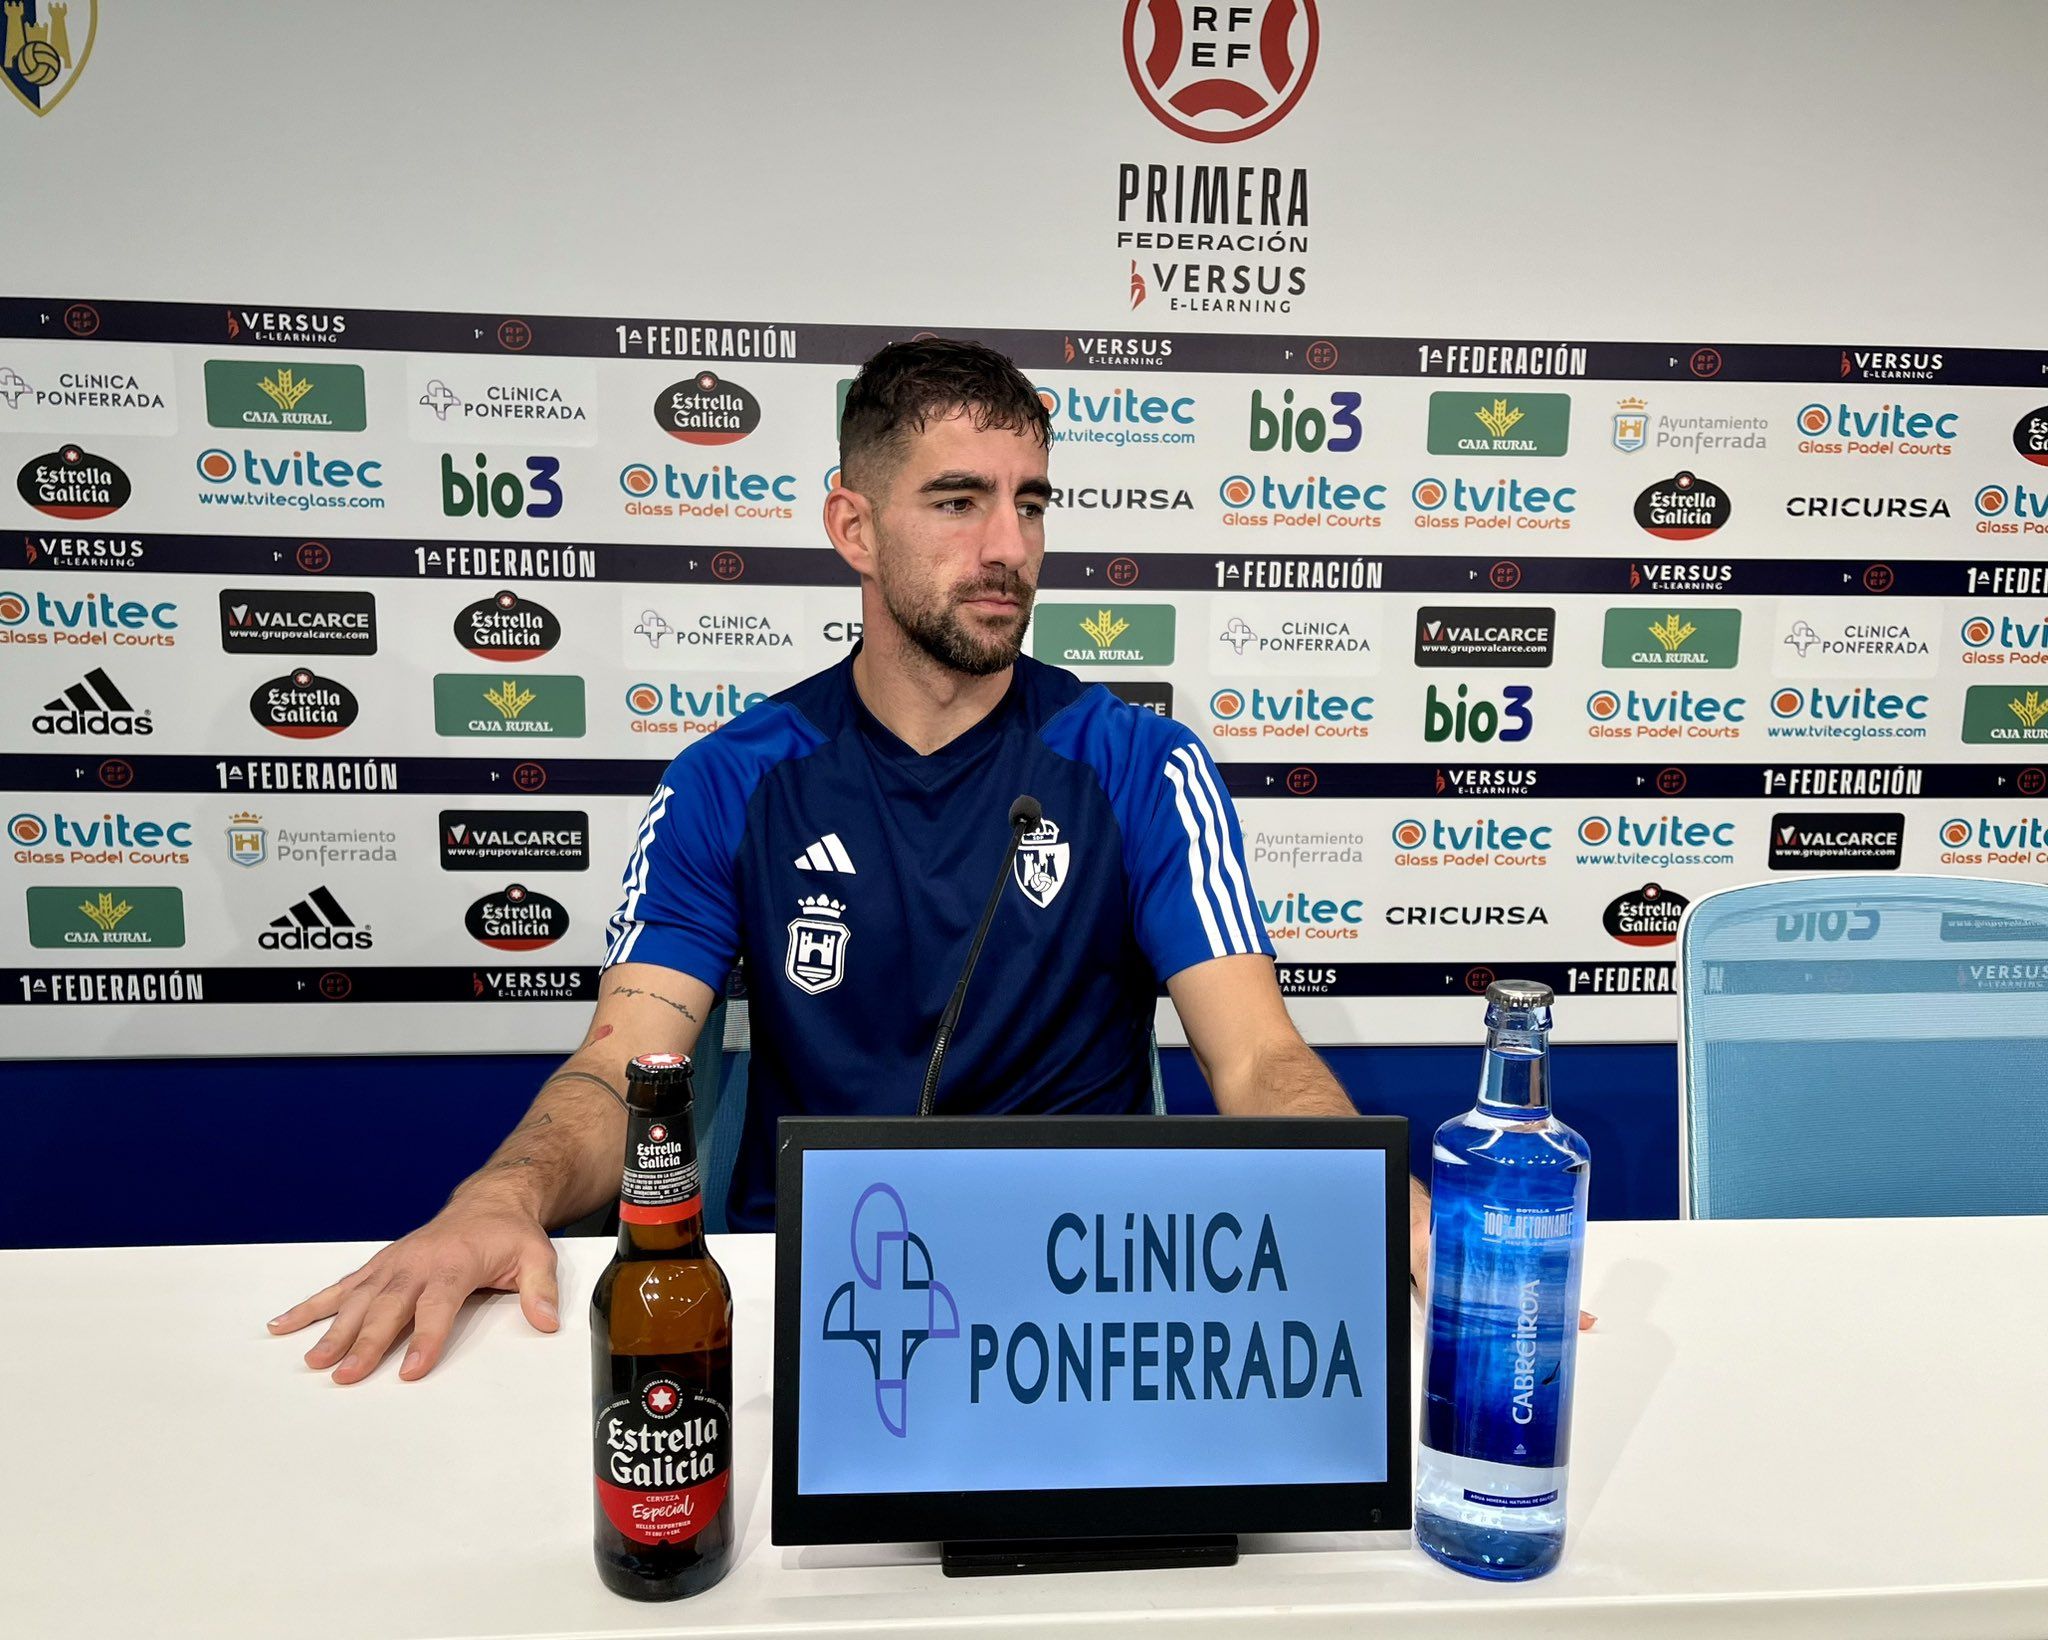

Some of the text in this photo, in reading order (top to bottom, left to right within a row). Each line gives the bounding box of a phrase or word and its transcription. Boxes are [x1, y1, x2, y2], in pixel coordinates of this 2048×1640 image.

[1118, 163, 1308, 226] PRIMERA
[1118, 231, 1307, 253] FEDERACIÓN
[1153, 263, 1306, 295] VERSUS
[1171, 298, 1290, 313] E-LEARNING
[242, 312, 345, 333] VERSUS
[255, 332, 337, 343] E-LEARNING
[647, 325, 796, 358] FEDERACIÓN
[1078, 338, 1172, 356] VERSUS
[1089, 356, 1163, 365] E-LEARNING
[1447, 343, 1587, 375] FEDERACIÓN
[1854, 352, 1943, 370] VERSUS
[1863, 370, 1933, 379] E-LEARNING
[36, 391, 164, 408] PONFERRADA
[671, 392, 743, 411] Estrella
[1068, 387, 1195, 424] tvitec
[243, 411, 332, 425] CAJA RURAL
[464, 403, 586, 420] PONFERRADA
[674, 410, 740, 428] Galicia
[1250, 388, 1362, 453] bio3
[1658, 415, 1768, 432] Ayuntamiento
[1838, 404, 1959, 439] tvitec
[1458, 439, 1537, 450] CAJA RURAL
[1657, 432, 1766, 454] Ponferrada
[1798, 440, 1951, 455] Glass Padel Courts
[35, 466, 112, 485] Estrella
[244, 449, 383, 488] tvitec
[441, 452, 563, 518] bio3
[665, 464, 796, 502] tvitec
[39, 484, 110, 503] Galicia
[198, 492, 385, 511] www.tvitecglass.com
[1049, 488, 1194, 510] RICURSA
[1262, 475, 1387, 511] tvitec
[1649, 491, 1716, 508] Estrella
[625, 501, 792, 519] Glass Padel Courts
[1651, 508, 1711, 524] Galicia
[1787, 497, 1951, 518] CRICURSA
[1222, 512, 1381, 527] Glass Padel Courts
[39, 538, 143, 557] VERSUS
[54, 557, 135, 567] E-LEARNING
[446, 545, 595, 578] FEDERACIÓN
[1244, 558, 1382, 589] FEDERACIÓN
[1643, 565, 1732, 581] VERSUS
[1652, 582, 1722, 590] E-LEARNING
[37, 592, 178, 629] tvitec
[255, 612, 369, 628] VALCARCE
[471, 611, 543, 629] Estrella
[54, 631, 107, 645] Padel
[113, 633, 175, 646] Courts
[229, 630, 369, 640] www.grupovalcarce.com
[474, 628, 540, 646] Galicia
[677, 632, 793, 646] PONFERRADA
[1447, 628, 1548, 642] VALCARCE
[1064, 649, 1144, 660] CAJA RURAL
[1422, 644, 1547, 654] www.grupovalcarce.com
[1822, 641, 1929, 654] PONFERRADA
[1631, 652, 1708, 663] CAJA RURAL
[267, 688, 340, 706] Estrella
[1252, 689, 1374, 721] tvitec
[1627, 690, 1746, 722] tvitec
[1811, 688, 1929, 719] tvitec
[271, 705, 338, 723] Galicia
[1424, 683, 1533, 743] bio3
[32, 710, 153, 735] adidas
[468, 720, 553, 732] CAJA RURAL
[1213, 724, 1368, 737] Glass Padel Courts
[1589, 725, 1739, 738] Glass Padel Courts
[1768, 725, 1926, 741] www.tvitecglass.com
[248, 759, 397, 790] FEDERACIÓN
[1449, 770, 1536, 785] VERSUS
[1789, 766, 1922, 795] FEDERACIÓN
[54, 813, 192, 847] tvitec
[278, 829, 396, 845] Ayuntamiento
[472, 831, 582, 845] VALCARCE
[1433, 819, 1552, 850] tvitec
[1618, 816, 1735, 847] tvitec
[1800, 832, 1897, 846] VALCARCE
[1256, 832, 1363, 848] Ayuntamiento
[14, 850, 189, 864] Glass Padel Courts
[278, 845, 397, 867] Ponferrada
[448, 847, 582, 858] www.grupovalcarce.com
[1254, 847, 1363, 868] Ponferrada
[1395, 853, 1546, 866] Glass Padel Courts
[1576, 853, 1733, 868] www.tvitecglass.com
[1775, 847, 1895, 858] www.grupovalcarce.com
[1941, 851, 2031, 864] Glass Padel
[482, 903, 552, 920] Estrella
[1386, 906, 1548, 925] CRICURSA
[485, 919, 549, 936] Galicia
[64, 932, 151, 943] CAJA RURAL
[258, 925, 373, 950] adidas
[52, 970, 203, 1001] FEDERACIÓN
[486, 973, 581, 988] VERSUS
[498, 989, 572, 997] E-LEARNING
[637, 1142, 681, 1156] Estrella
[638, 1155, 680, 1169] Galicia
[1516, 1212, 1573, 1239] RETORNABLE
[971, 1320, 1363, 1404] PONFERRADA
[607, 1417, 718, 1454] Estrella
[610, 1450, 715, 1486] Galicia
[646, 1494, 680, 1503] CERVEZA
[632, 1495, 694, 1522] Especial
